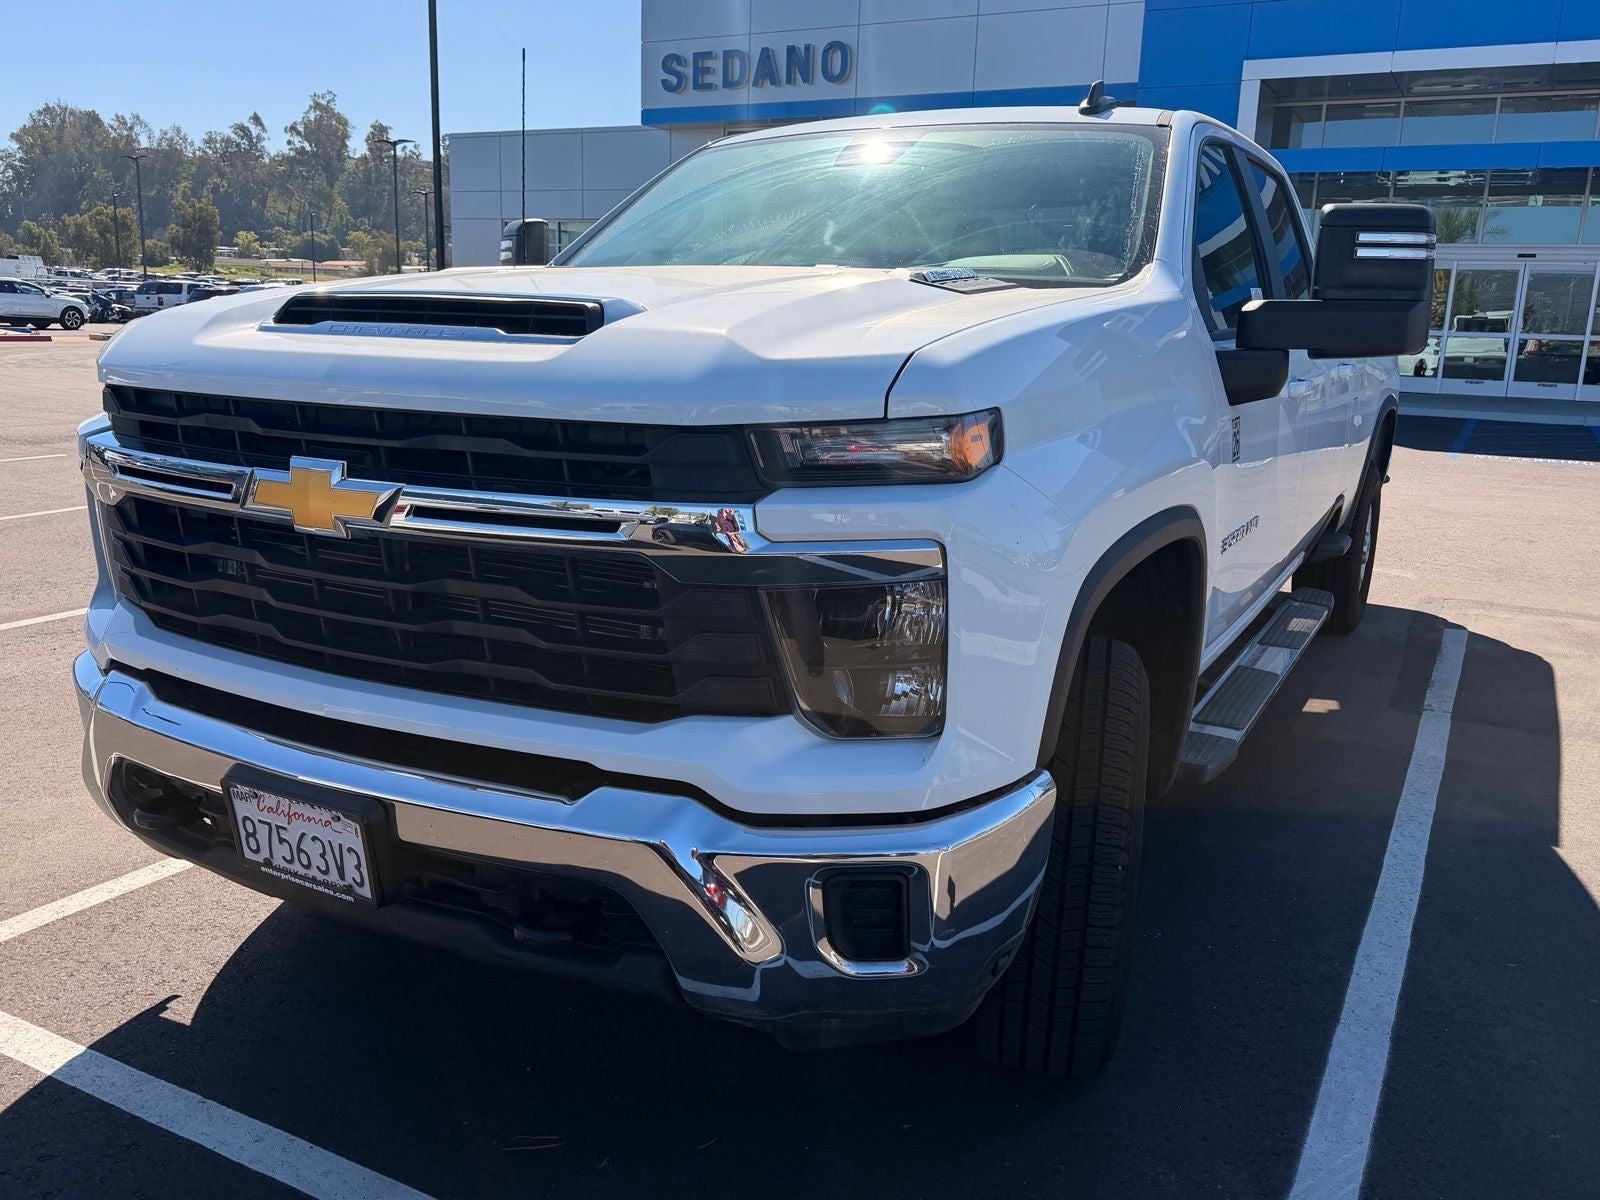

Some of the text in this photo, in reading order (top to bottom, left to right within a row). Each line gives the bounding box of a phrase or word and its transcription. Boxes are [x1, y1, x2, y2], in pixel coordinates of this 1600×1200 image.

[660, 40, 851, 94] SEDANO
[328, 324, 473, 339] CHEVROLET
[1508, 456, 1596, 466] PARKING
[256, 794, 343, 834] California
[241, 815, 365, 888] 87563V3
[260, 866, 355, 903] enterprisecarsales.com
